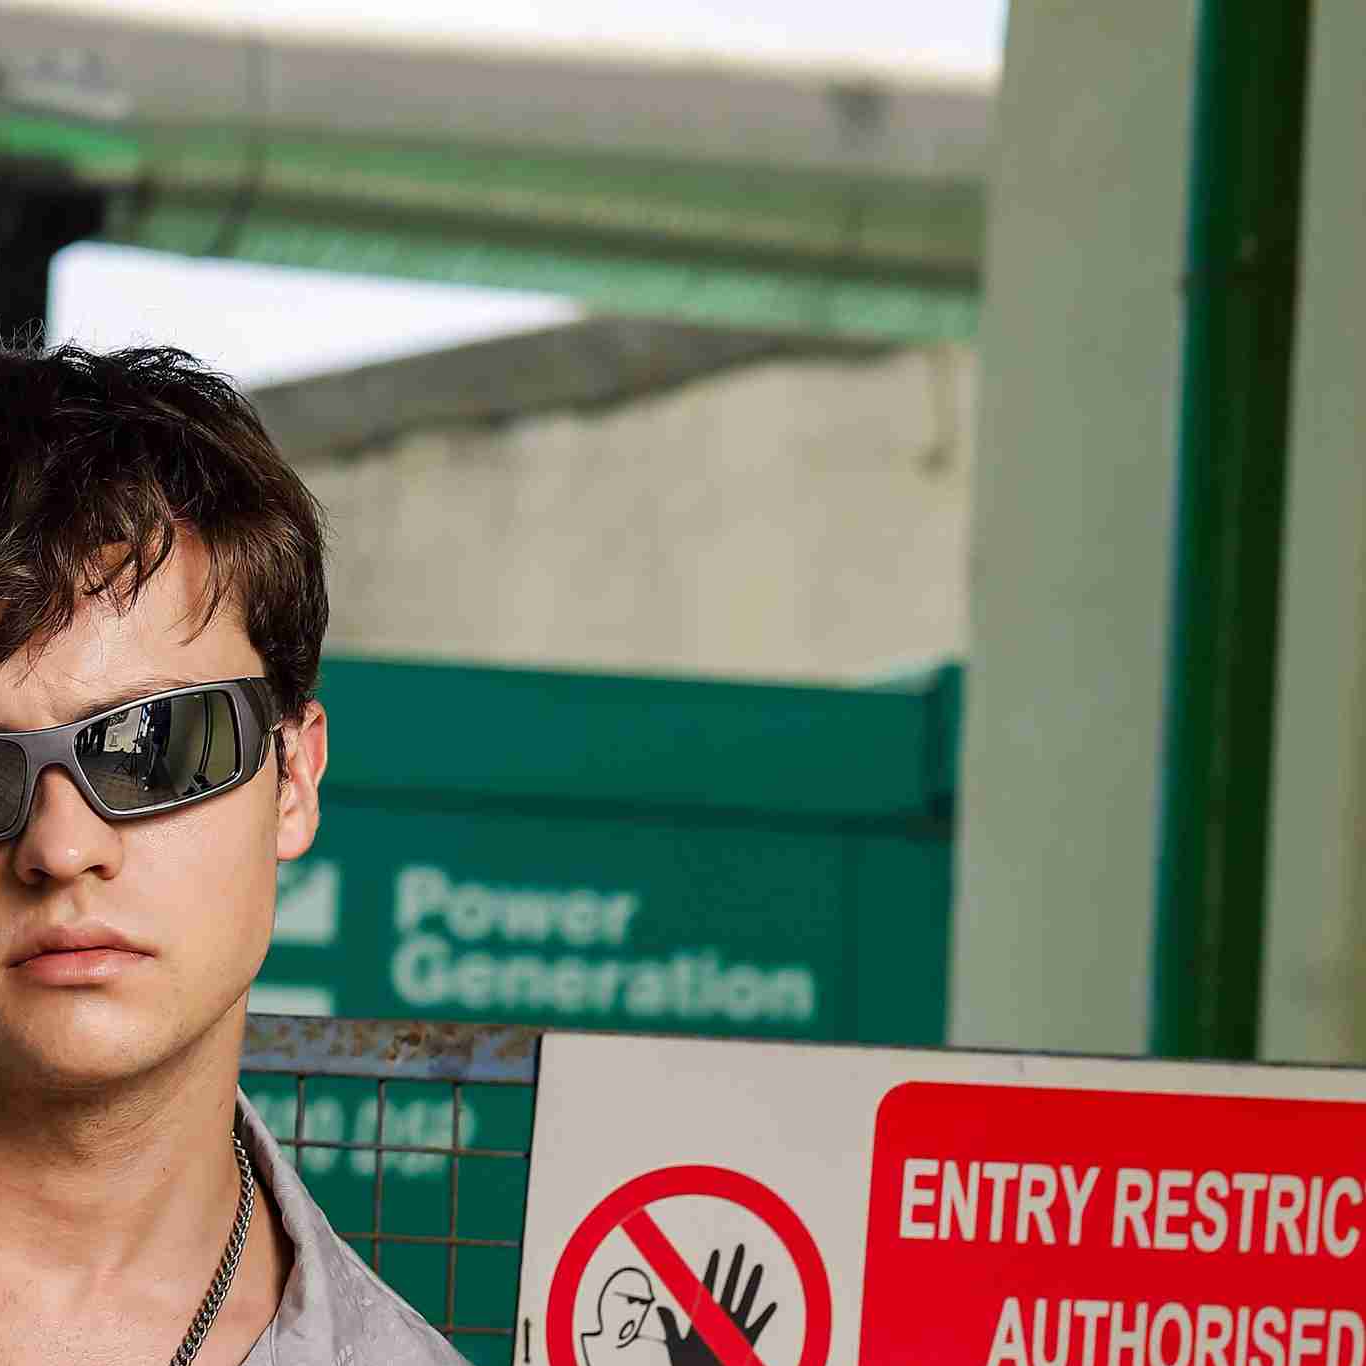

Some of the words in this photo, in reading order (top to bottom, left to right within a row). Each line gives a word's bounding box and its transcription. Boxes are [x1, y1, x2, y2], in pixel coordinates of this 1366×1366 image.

[395, 866, 637, 944] Power
[391, 934, 815, 1020] Generation
[899, 1158, 1101, 1247] ENTRY
[1111, 1167, 1366, 1259] RESTRIC
